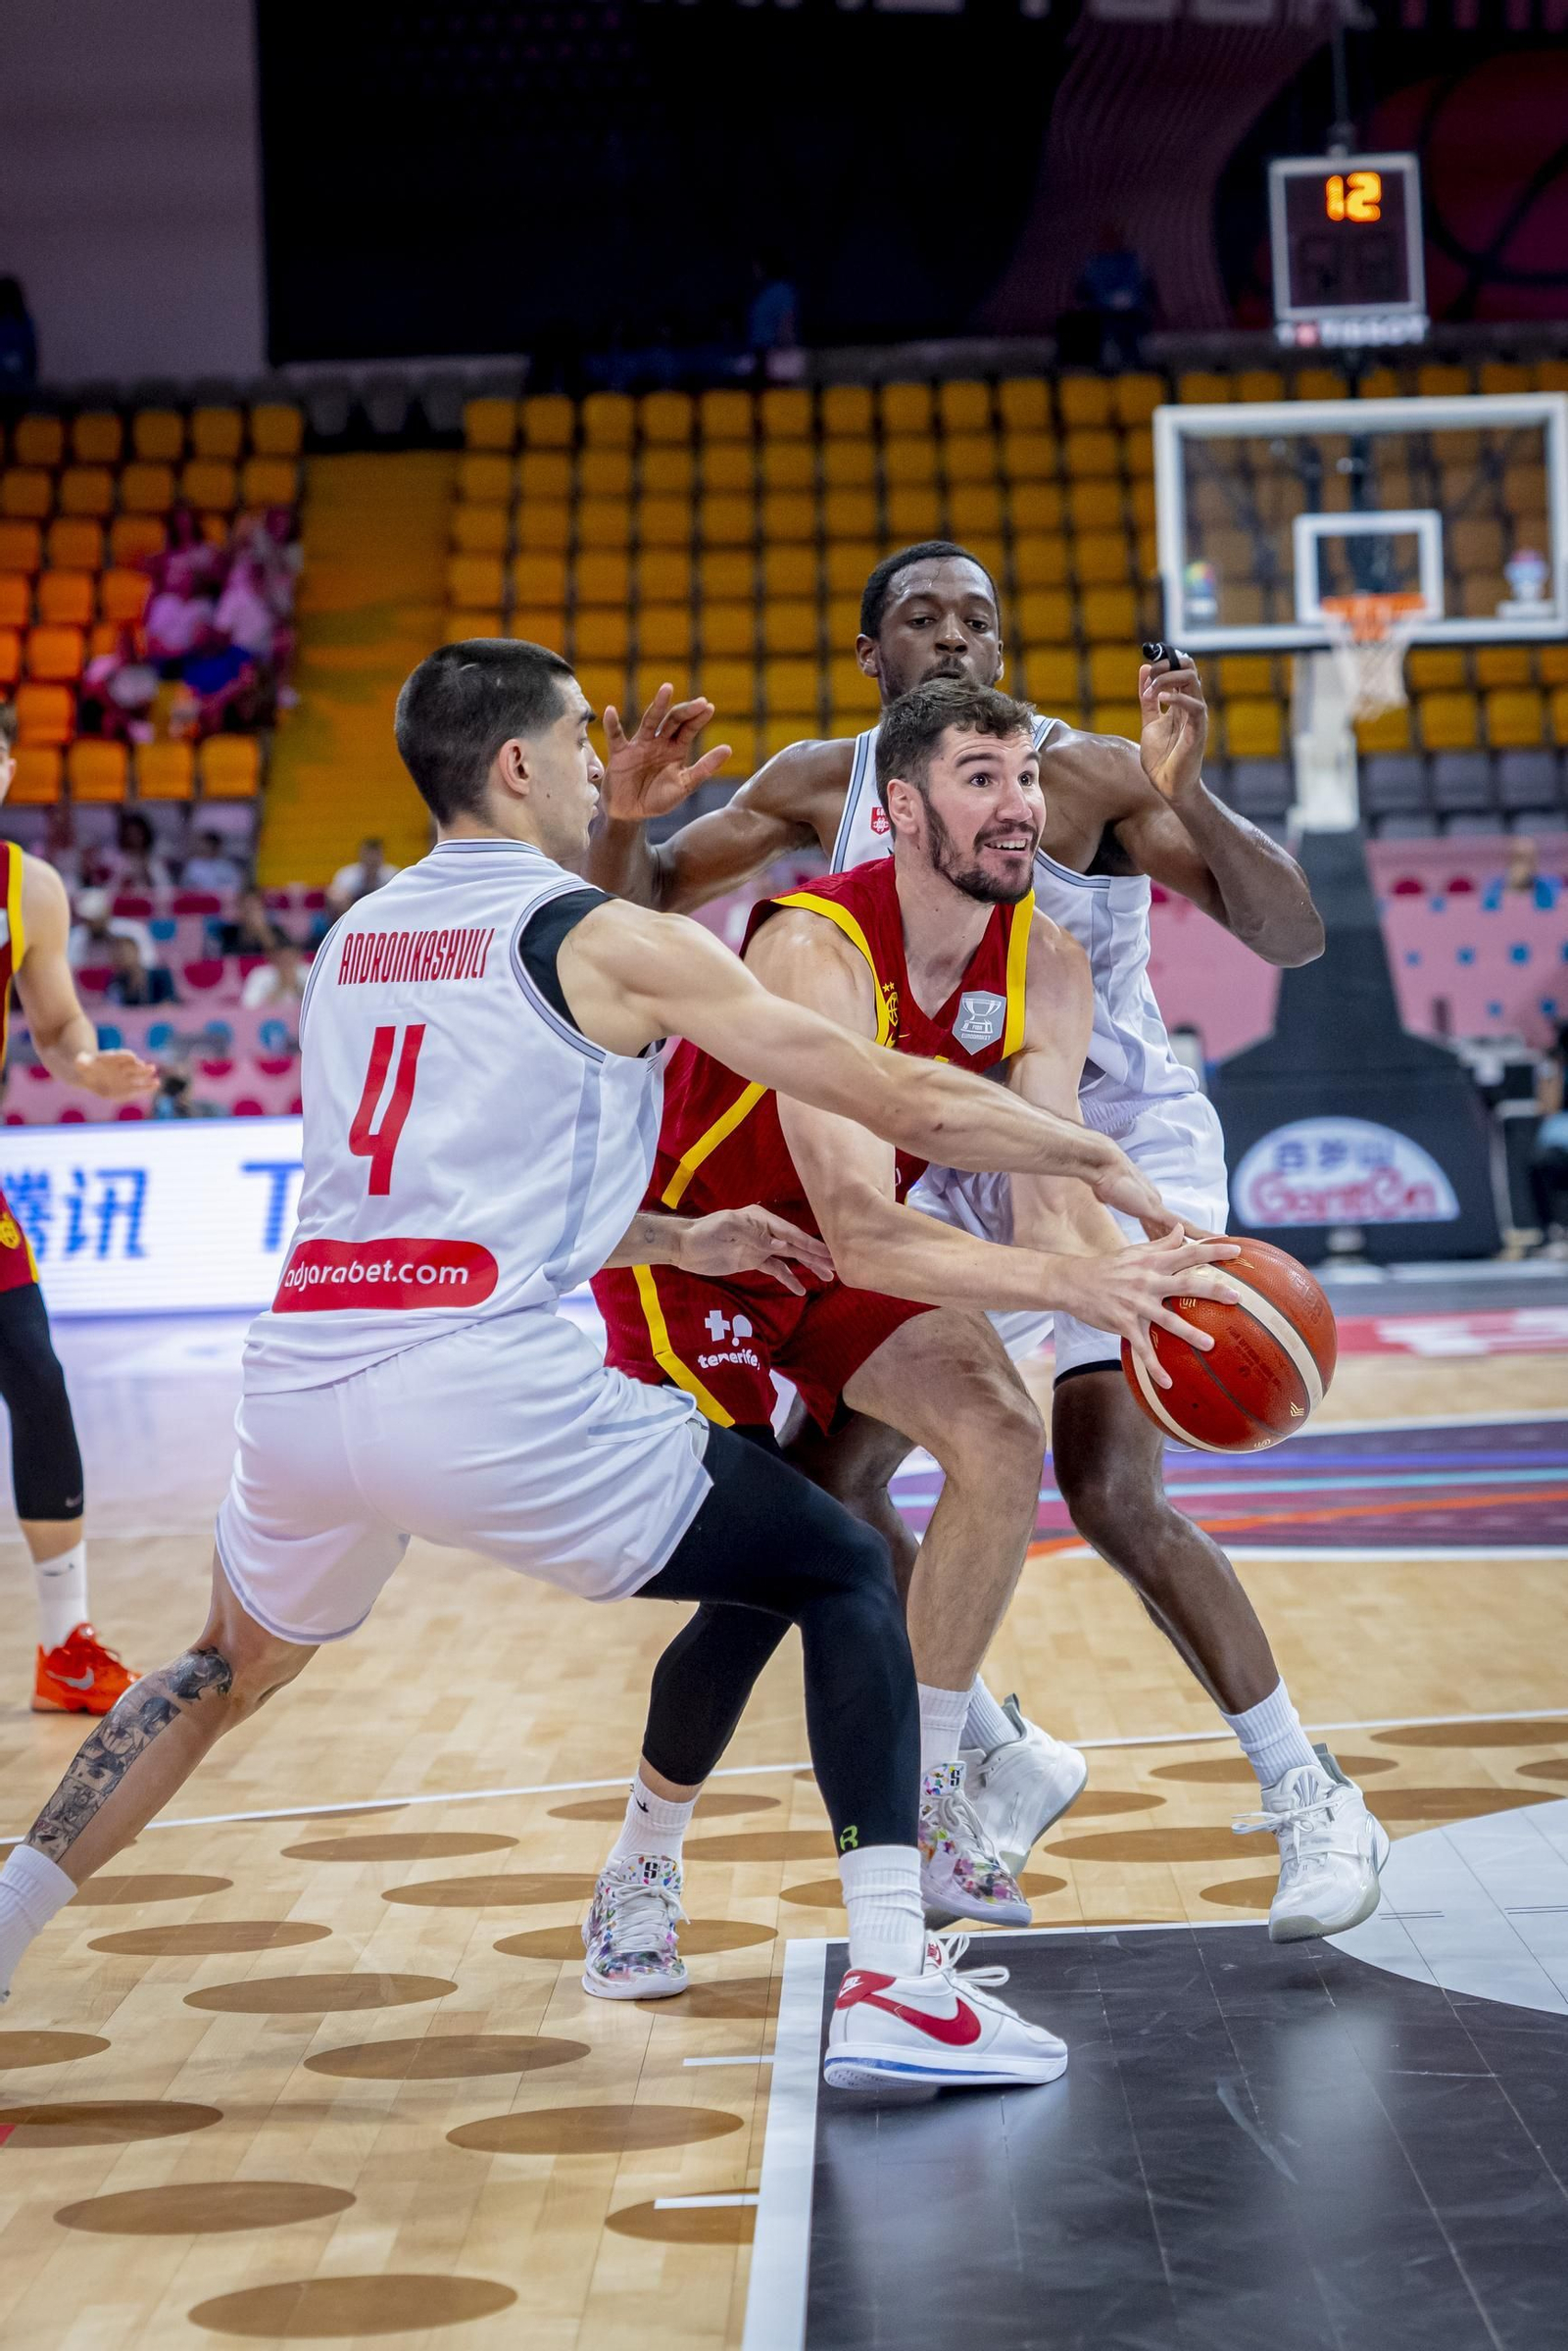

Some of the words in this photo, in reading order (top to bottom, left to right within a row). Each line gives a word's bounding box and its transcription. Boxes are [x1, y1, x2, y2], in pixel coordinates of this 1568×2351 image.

[1326, 171, 1382, 222] 12
[338, 928, 495, 986] ANDRONIKASHVILI
[349, 1024, 426, 1196] 4
[284, 1259, 469, 1292] adjarabet.com
